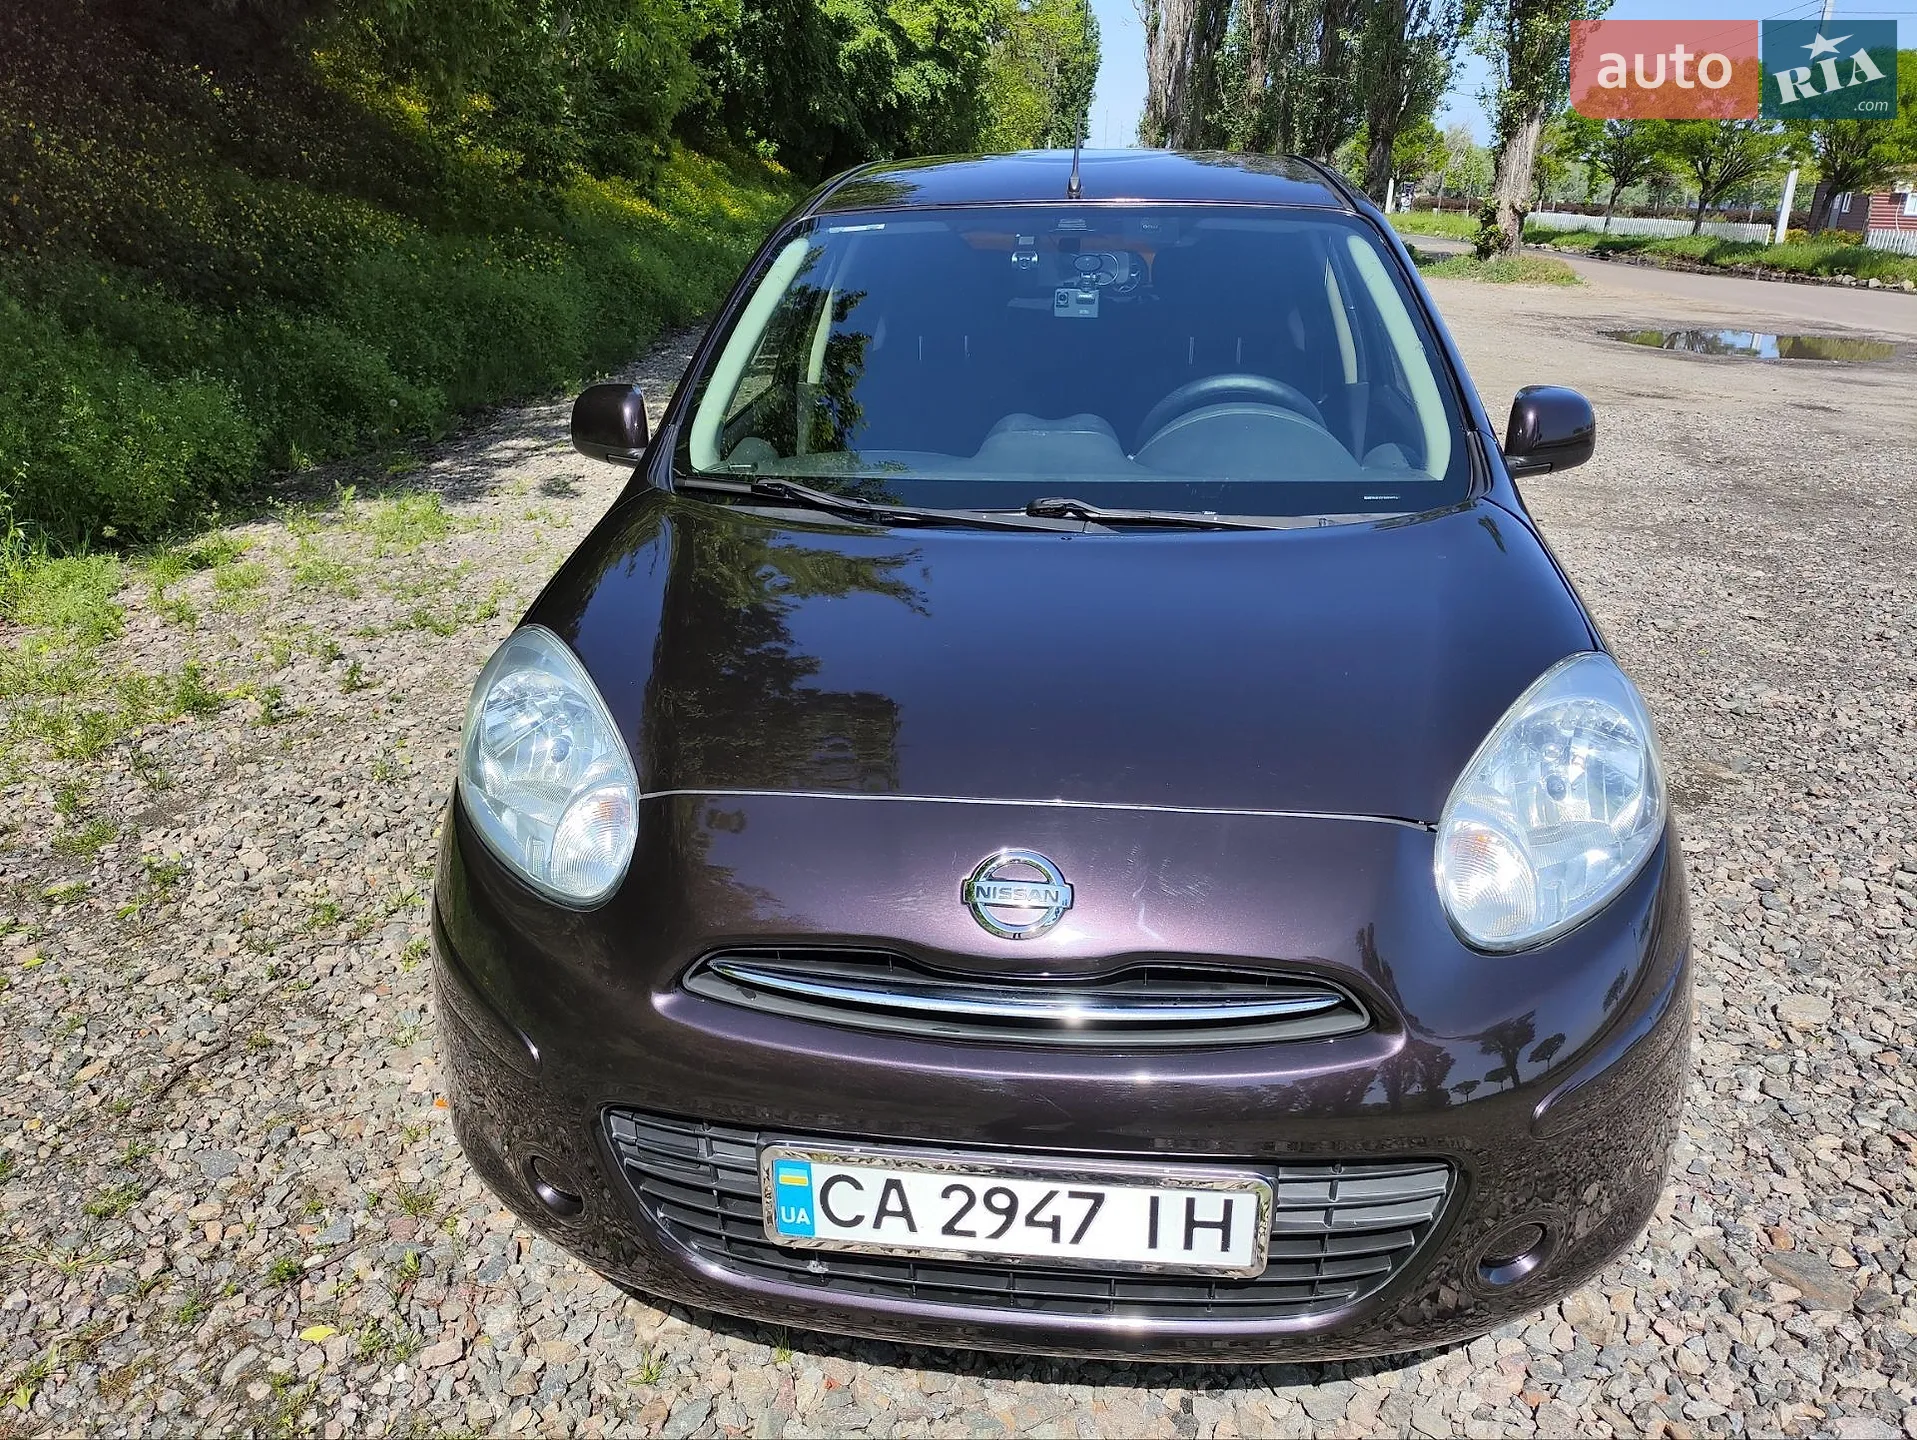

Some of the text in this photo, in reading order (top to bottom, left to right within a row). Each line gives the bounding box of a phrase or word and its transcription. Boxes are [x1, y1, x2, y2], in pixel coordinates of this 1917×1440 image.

[975, 885, 1059, 903] NISSAN
[781, 1205, 811, 1225] UA
[819, 1173, 1235, 1252] CA 2947 IH
